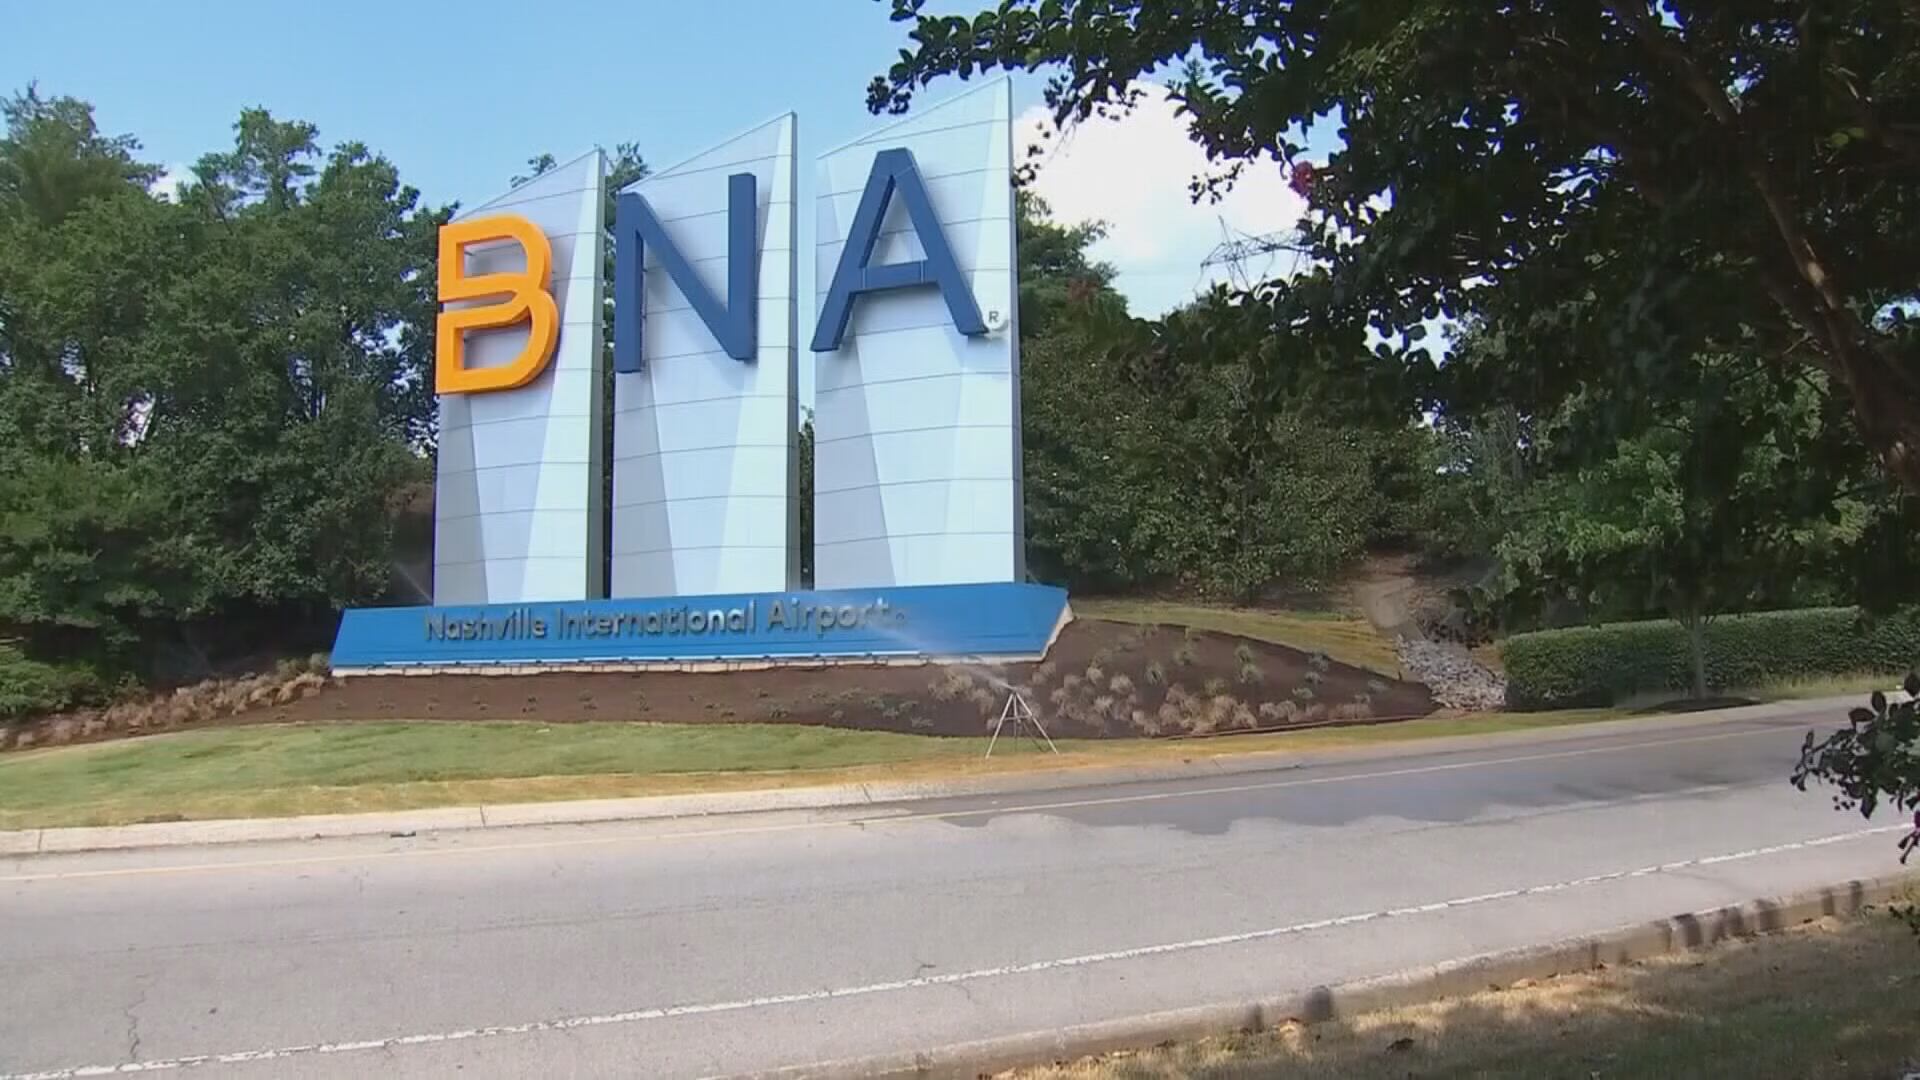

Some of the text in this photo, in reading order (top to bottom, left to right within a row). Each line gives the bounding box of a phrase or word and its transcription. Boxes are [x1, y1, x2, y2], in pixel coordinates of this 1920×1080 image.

[435, 148, 987, 395] BNA
[425, 597, 889, 641] Nashville International Airport
